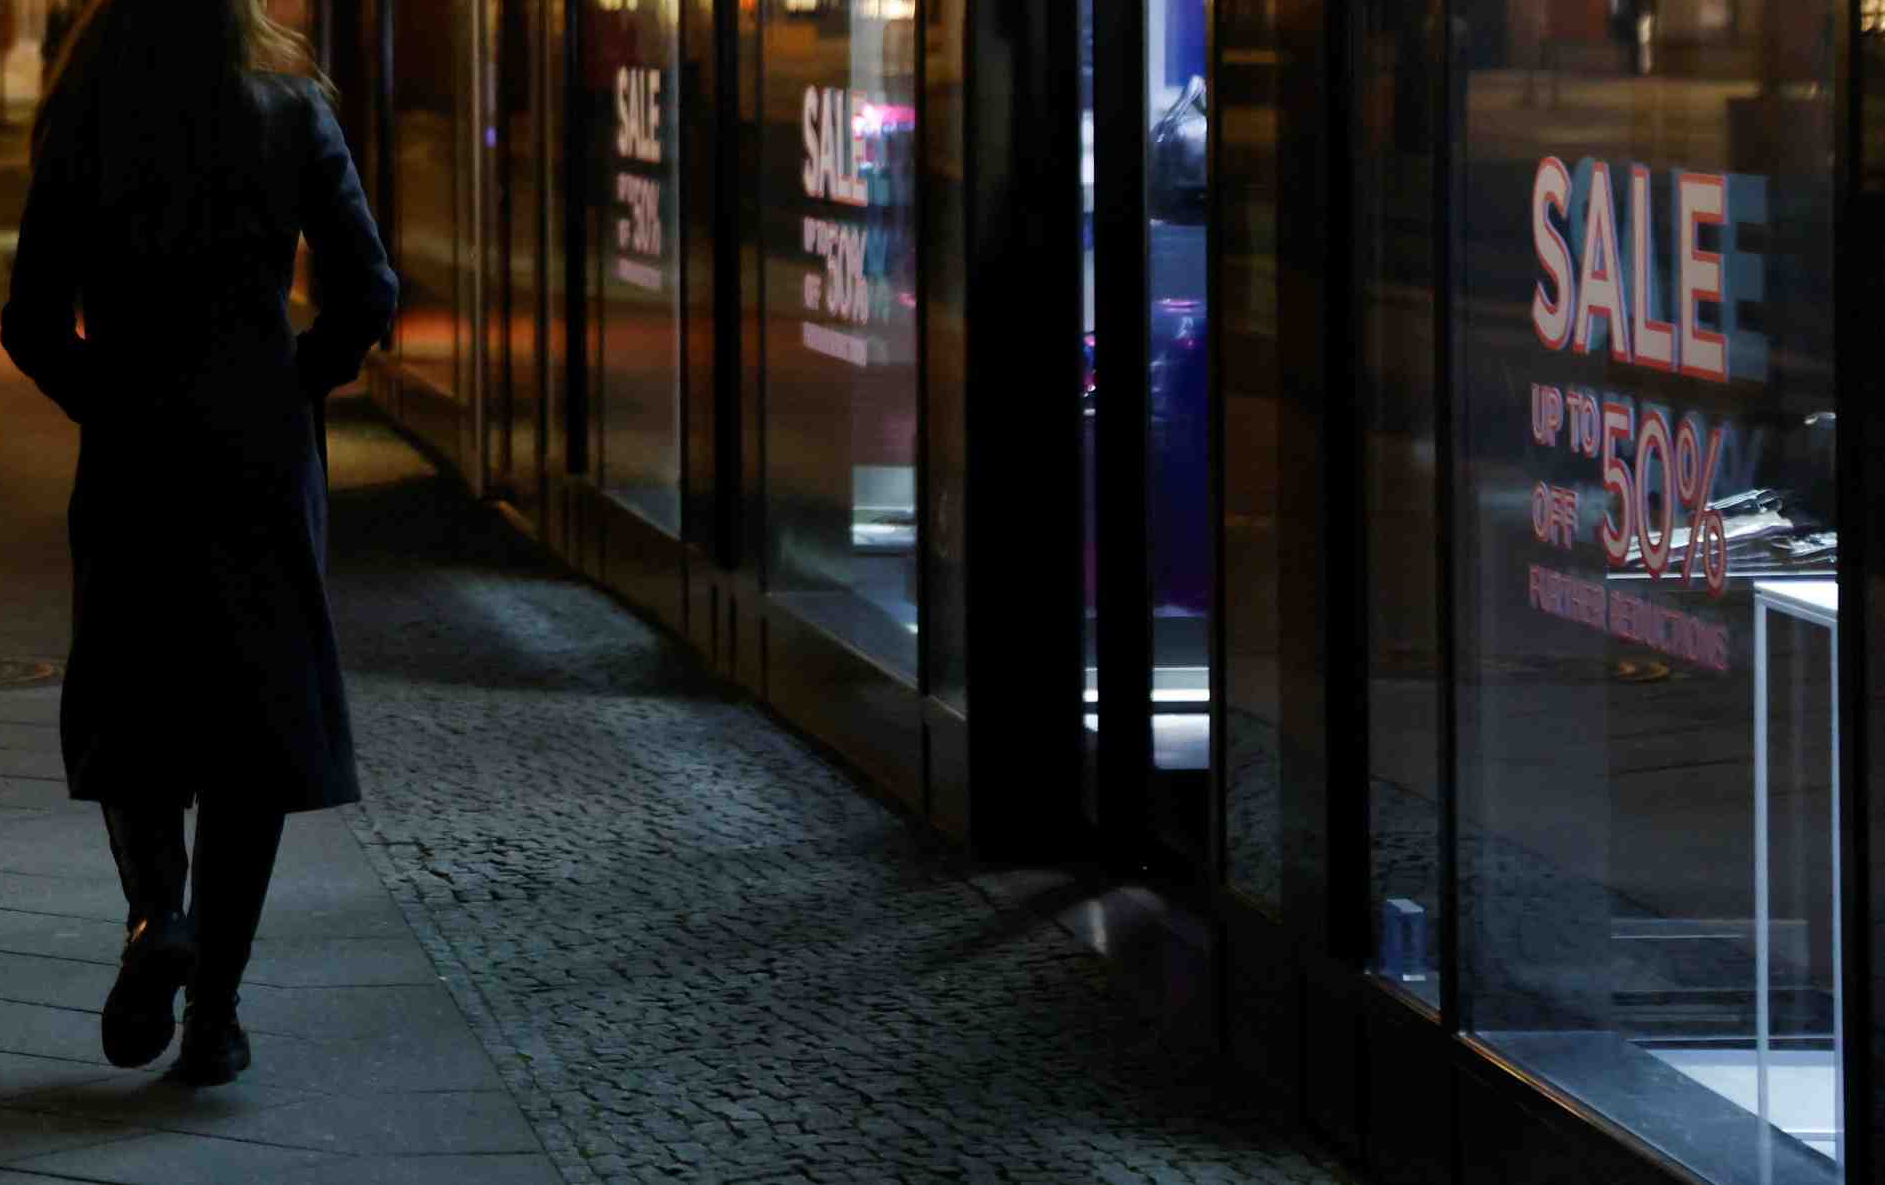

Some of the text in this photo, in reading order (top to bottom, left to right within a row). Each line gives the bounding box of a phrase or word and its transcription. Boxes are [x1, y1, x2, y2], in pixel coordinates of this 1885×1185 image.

[617, 65, 661, 163] SALE
[803, 85, 868, 206] SALE
[1532, 156, 1729, 382] SALE
[1530, 382, 1602, 459] UP TO
[1531, 478, 1580, 550] OFF
[1601, 401, 1728, 596] 50%
